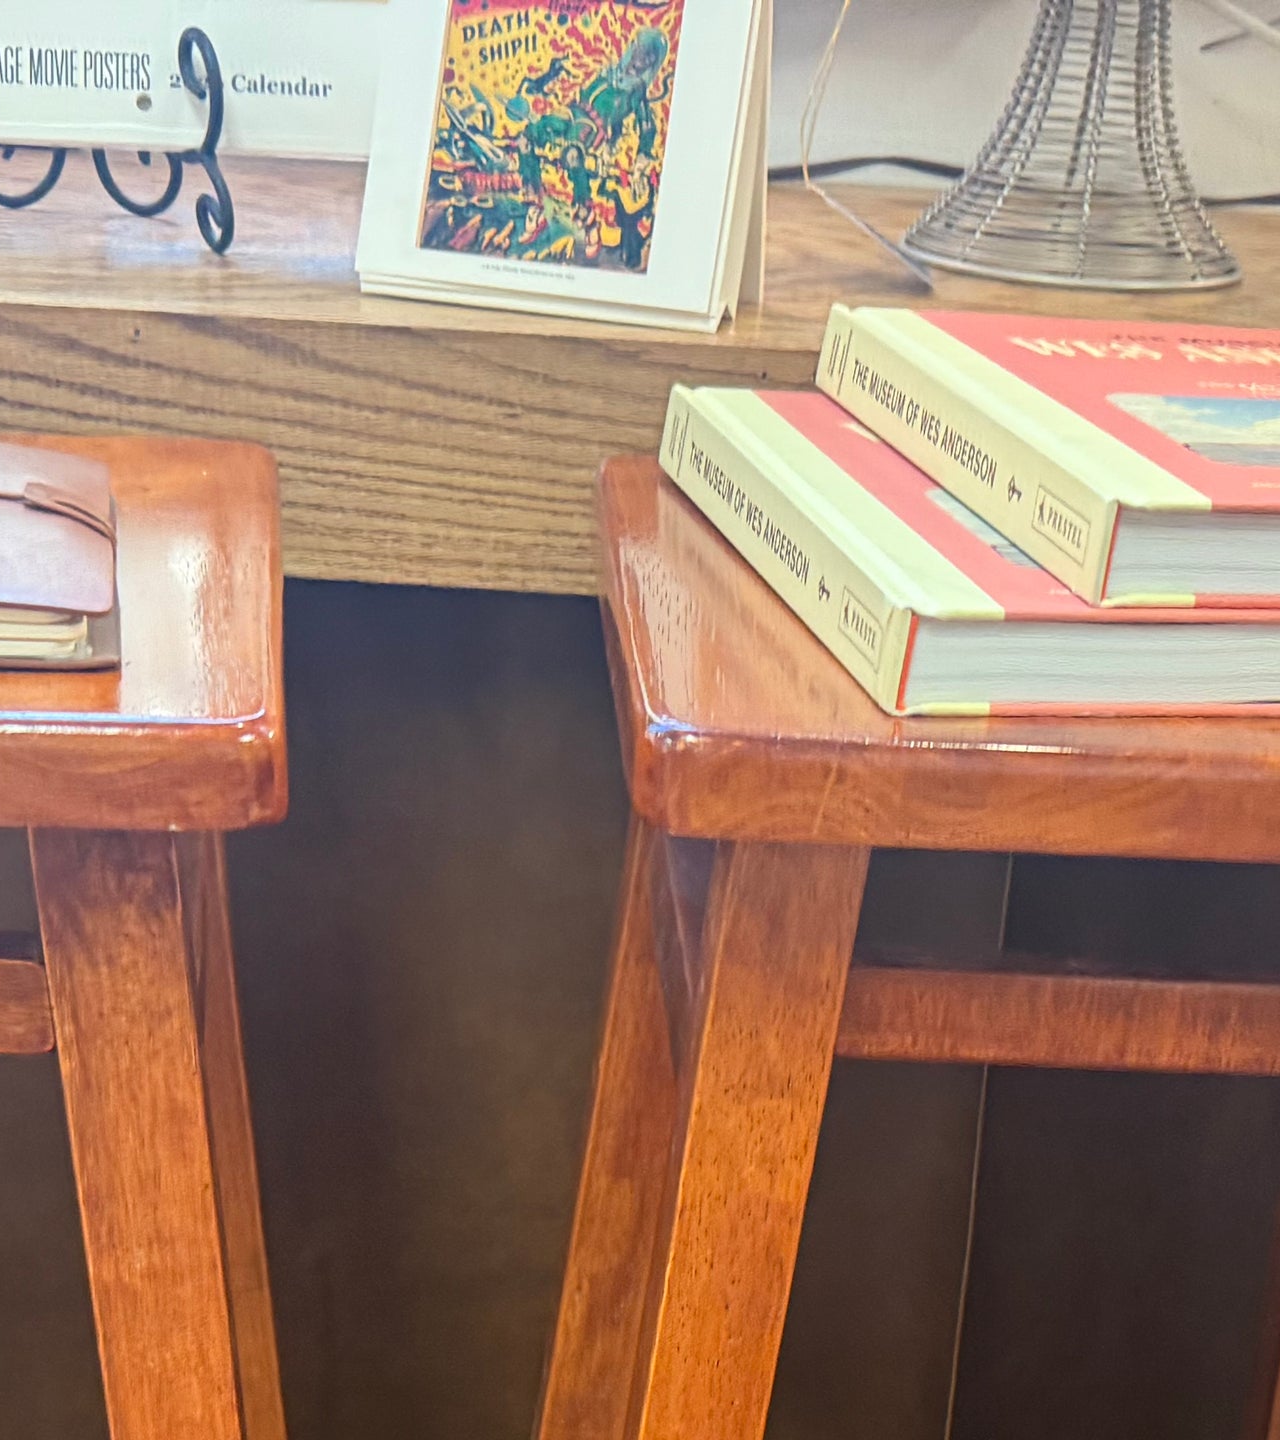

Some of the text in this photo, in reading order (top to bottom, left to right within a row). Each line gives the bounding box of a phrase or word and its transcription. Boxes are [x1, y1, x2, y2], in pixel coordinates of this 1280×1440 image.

[463, 9, 530, 43] DEATH
[29, 47, 78, 88] MOVIE
[84, 50, 151, 92] POSTERS
[231, 74, 333, 99] Calendar
[852, 358, 998, 490] THE MUSEUM OF WES ANDERSON
[689, 440, 811, 586] THE MUSEUM OF WES ANDERSON
[1047, 506, 1082, 550] PRESTEL
